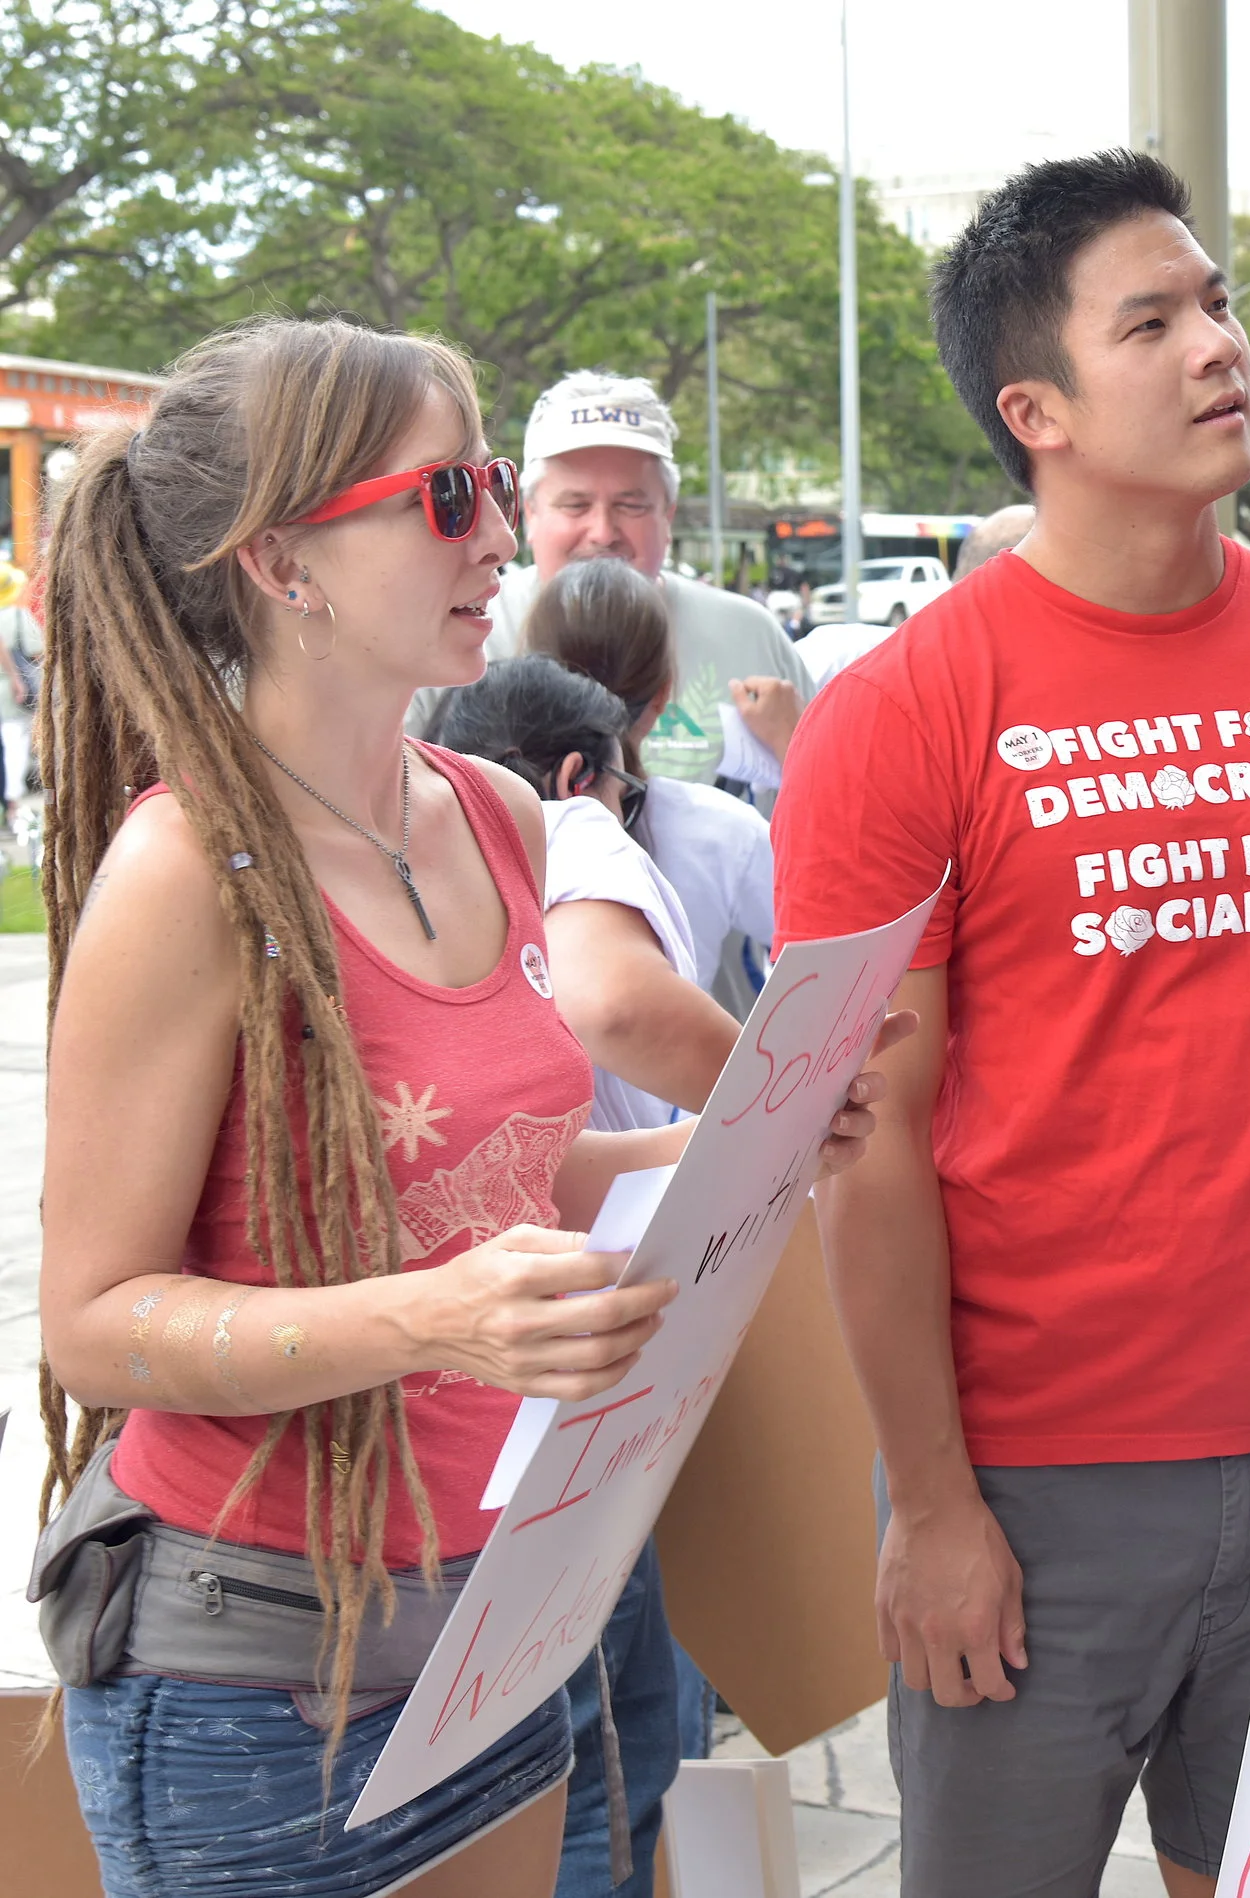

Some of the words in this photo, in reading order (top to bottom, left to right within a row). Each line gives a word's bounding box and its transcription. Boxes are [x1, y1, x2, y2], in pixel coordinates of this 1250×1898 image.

[571, 406, 641, 426] ILWU
[1004, 734, 1028, 748] MAY
[1032, 732, 1038, 740] 1
[1047, 713, 1203, 765] FIGHT
[1012, 746, 1043, 757] WORKERS
[1024, 755, 1038, 763] DAY
[1074, 838, 1230, 898] FIGHT
[695, 1134, 816, 1285] with
